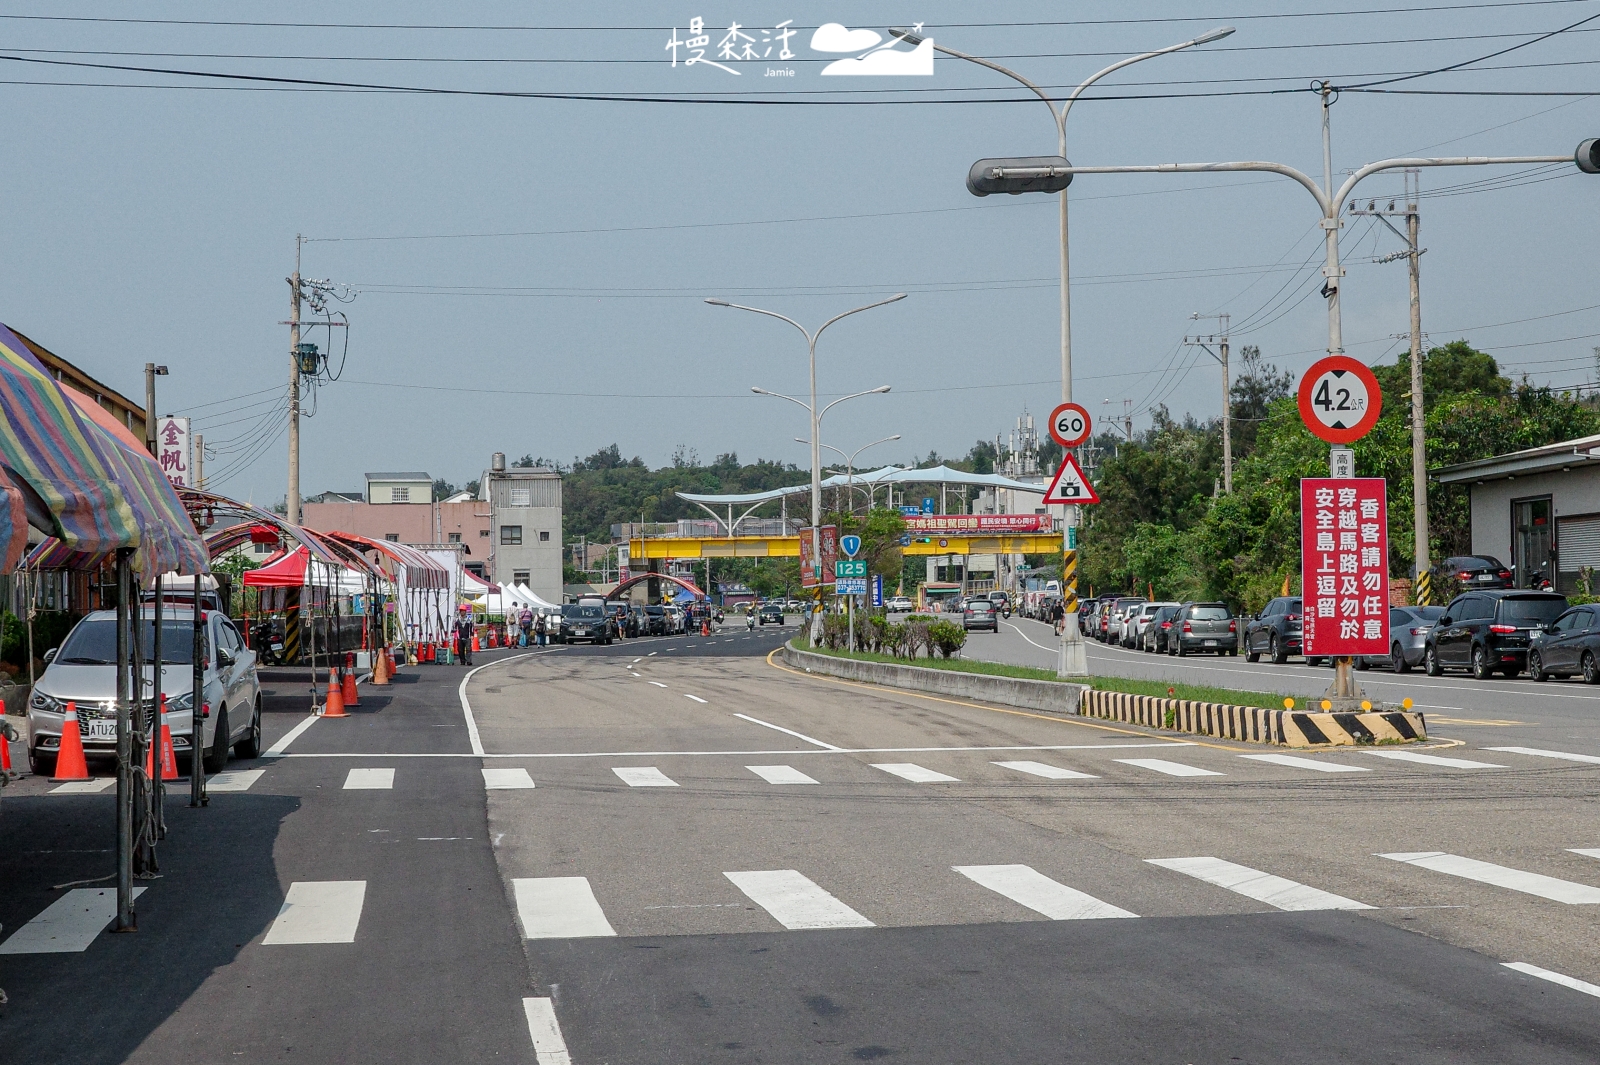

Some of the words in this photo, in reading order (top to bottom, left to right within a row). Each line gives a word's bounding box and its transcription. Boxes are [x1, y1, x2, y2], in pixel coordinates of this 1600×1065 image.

[1058, 418, 1082, 432] 60
[1337, 454, 1348, 478] 高度
[849, 538, 853, 550] 1
[1315, 488, 1336, 618] 安全島上逗留
[839, 563, 865, 575] 125
[1338, 488, 1360, 640] 穿越馬路及勿於
[1359, 498, 1382, 640] 香客請勿任意
